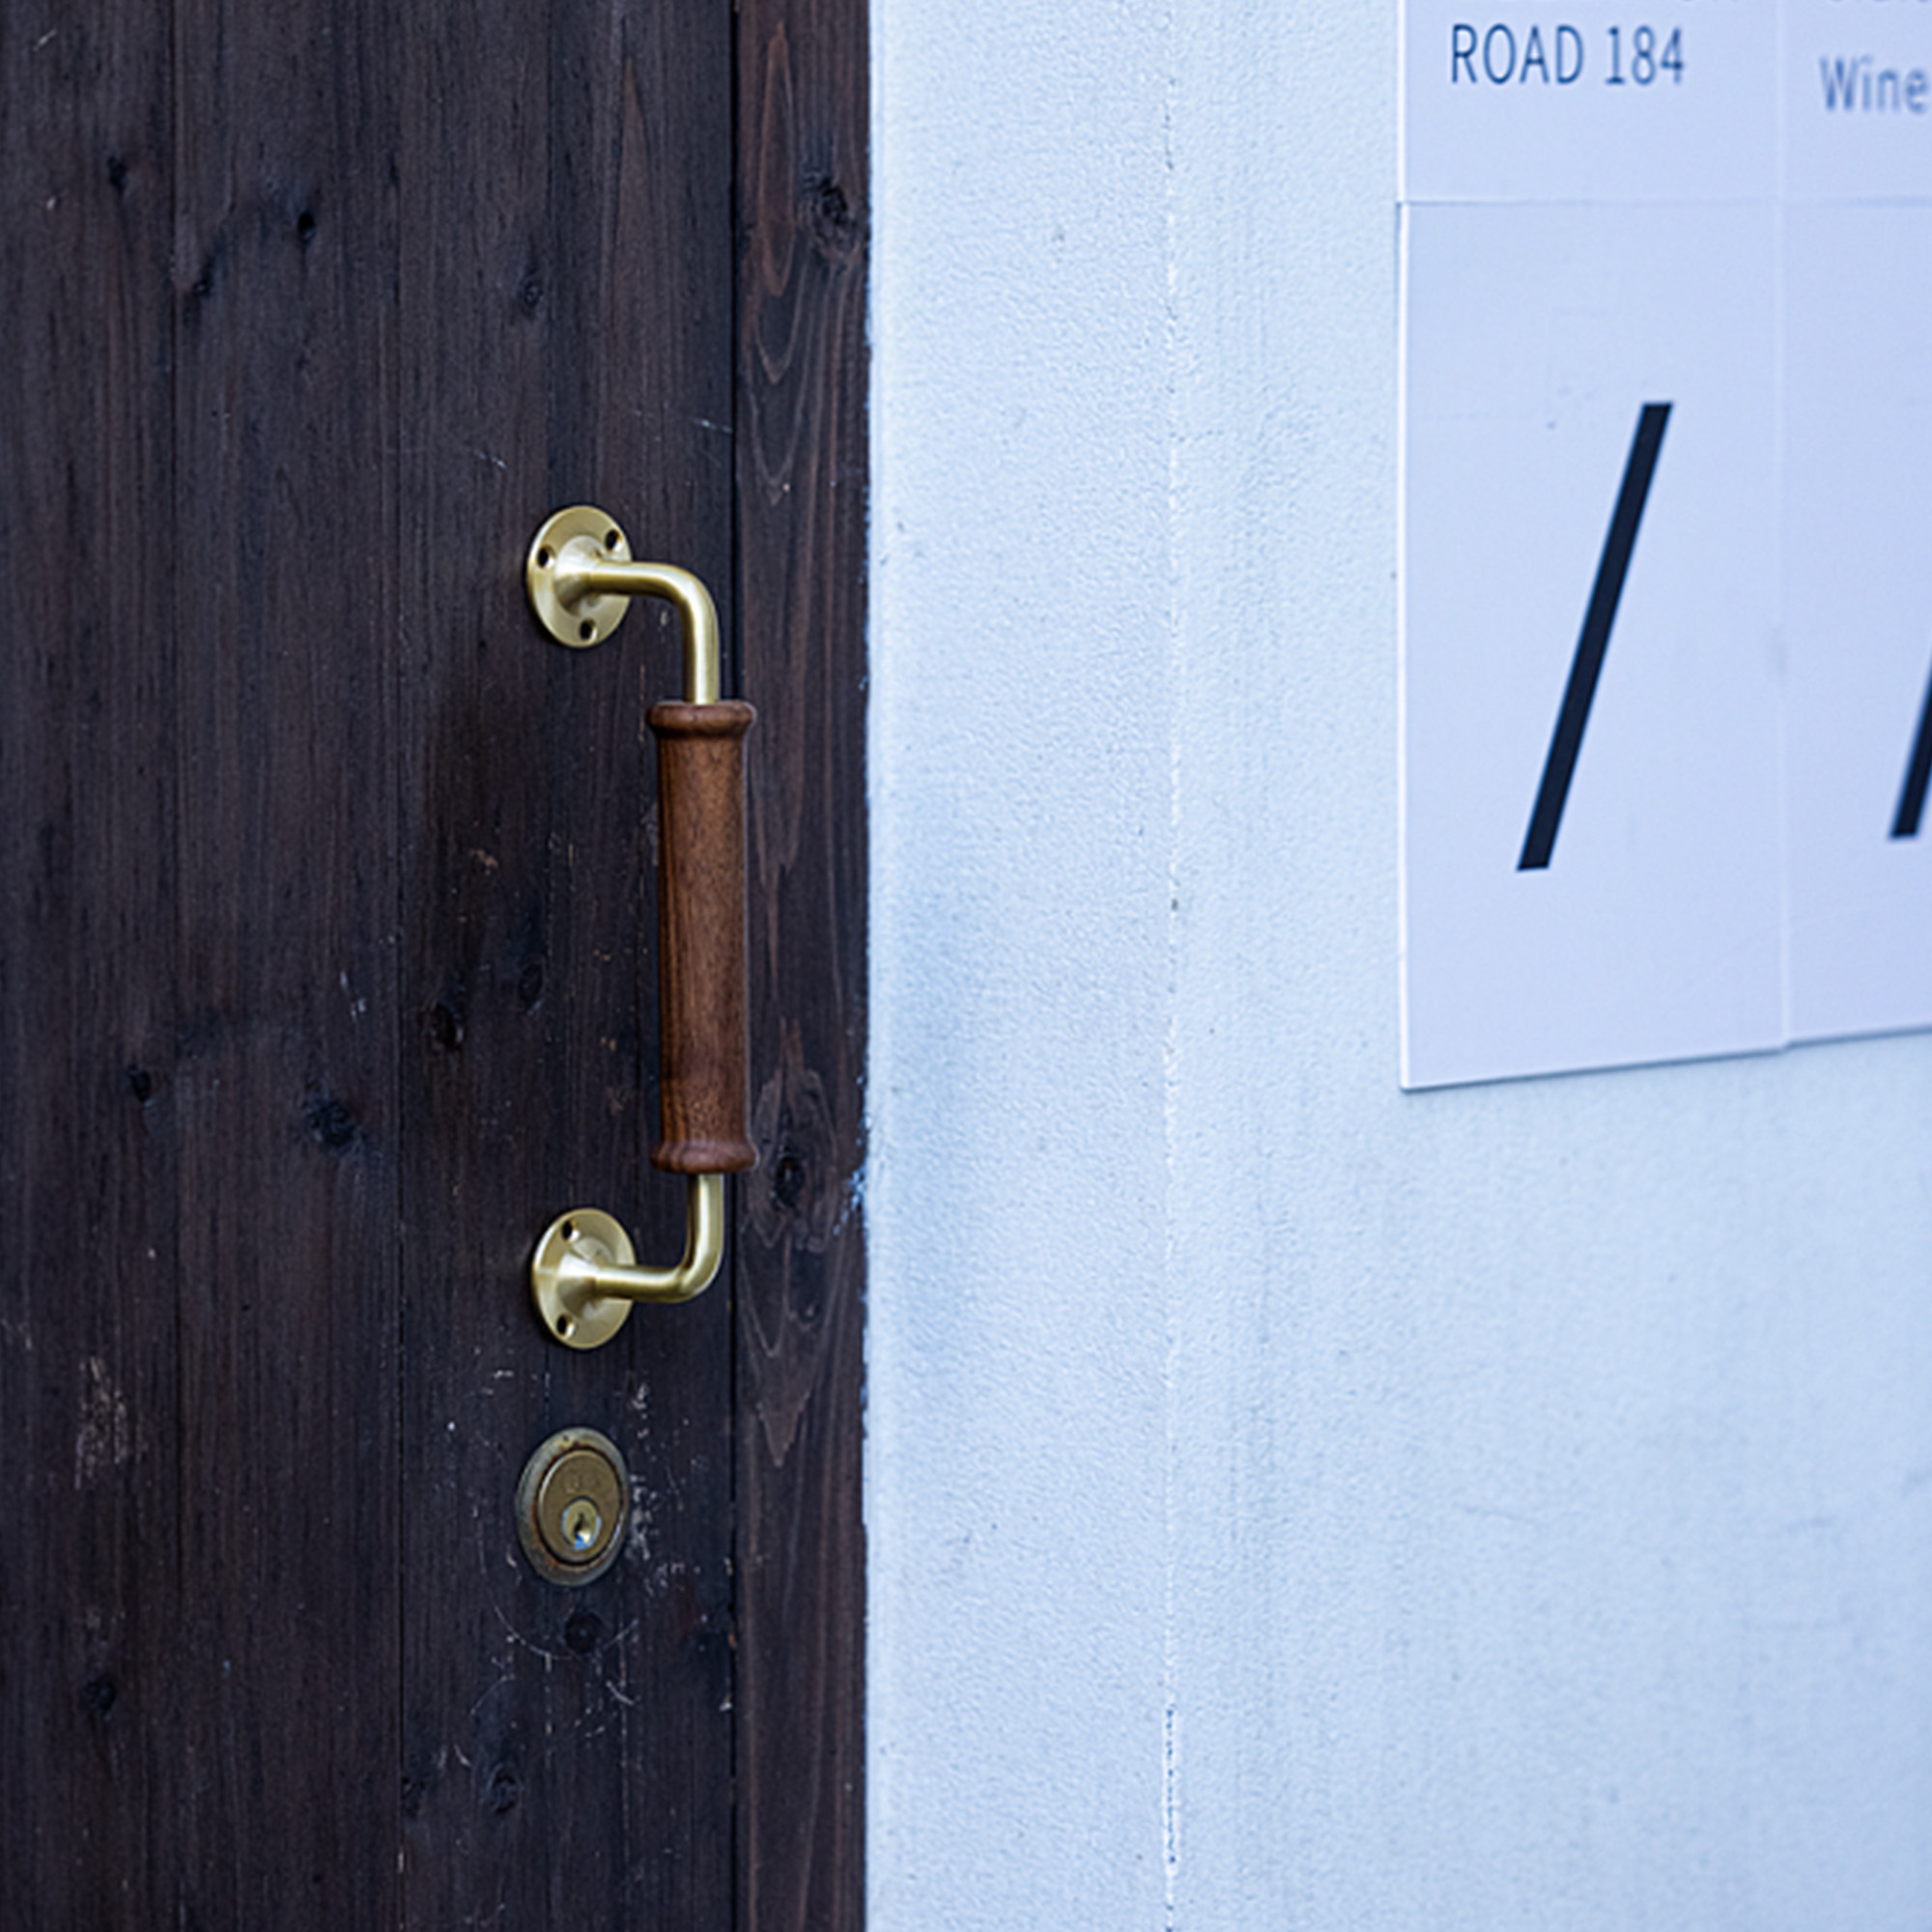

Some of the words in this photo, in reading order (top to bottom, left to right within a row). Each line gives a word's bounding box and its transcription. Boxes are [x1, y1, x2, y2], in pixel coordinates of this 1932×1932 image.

[1451, 22, 1585, 86] ROAD
[1605, 24, 1686, 87] 184
[1819, 54, 1931, 115] Wine
